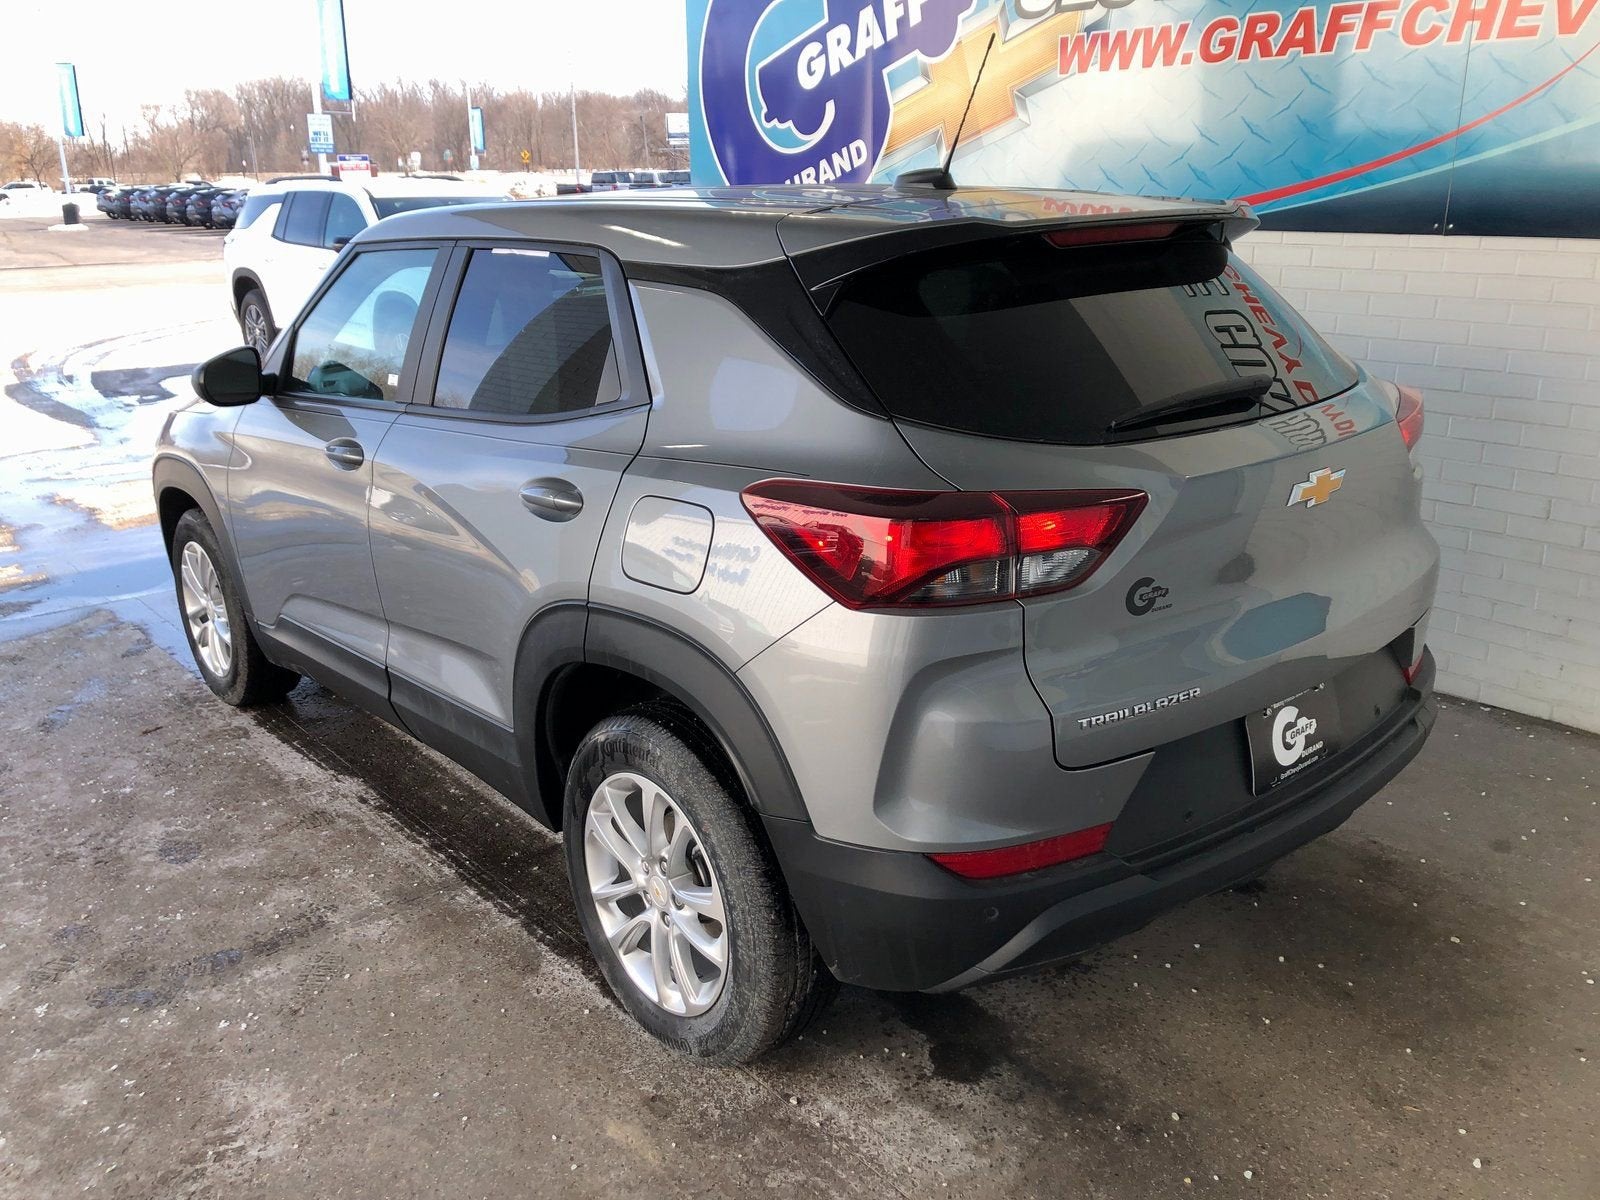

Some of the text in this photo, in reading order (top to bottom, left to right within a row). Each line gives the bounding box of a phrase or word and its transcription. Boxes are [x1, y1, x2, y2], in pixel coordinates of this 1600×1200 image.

[1142, 589, 1167, 600] GRAFF
[1077, 687, 1201, 728] TRAILBLAZER
[1290, 721, 1314, 740] GRAFF
[1301, 740, 1324, 758] DURAND
